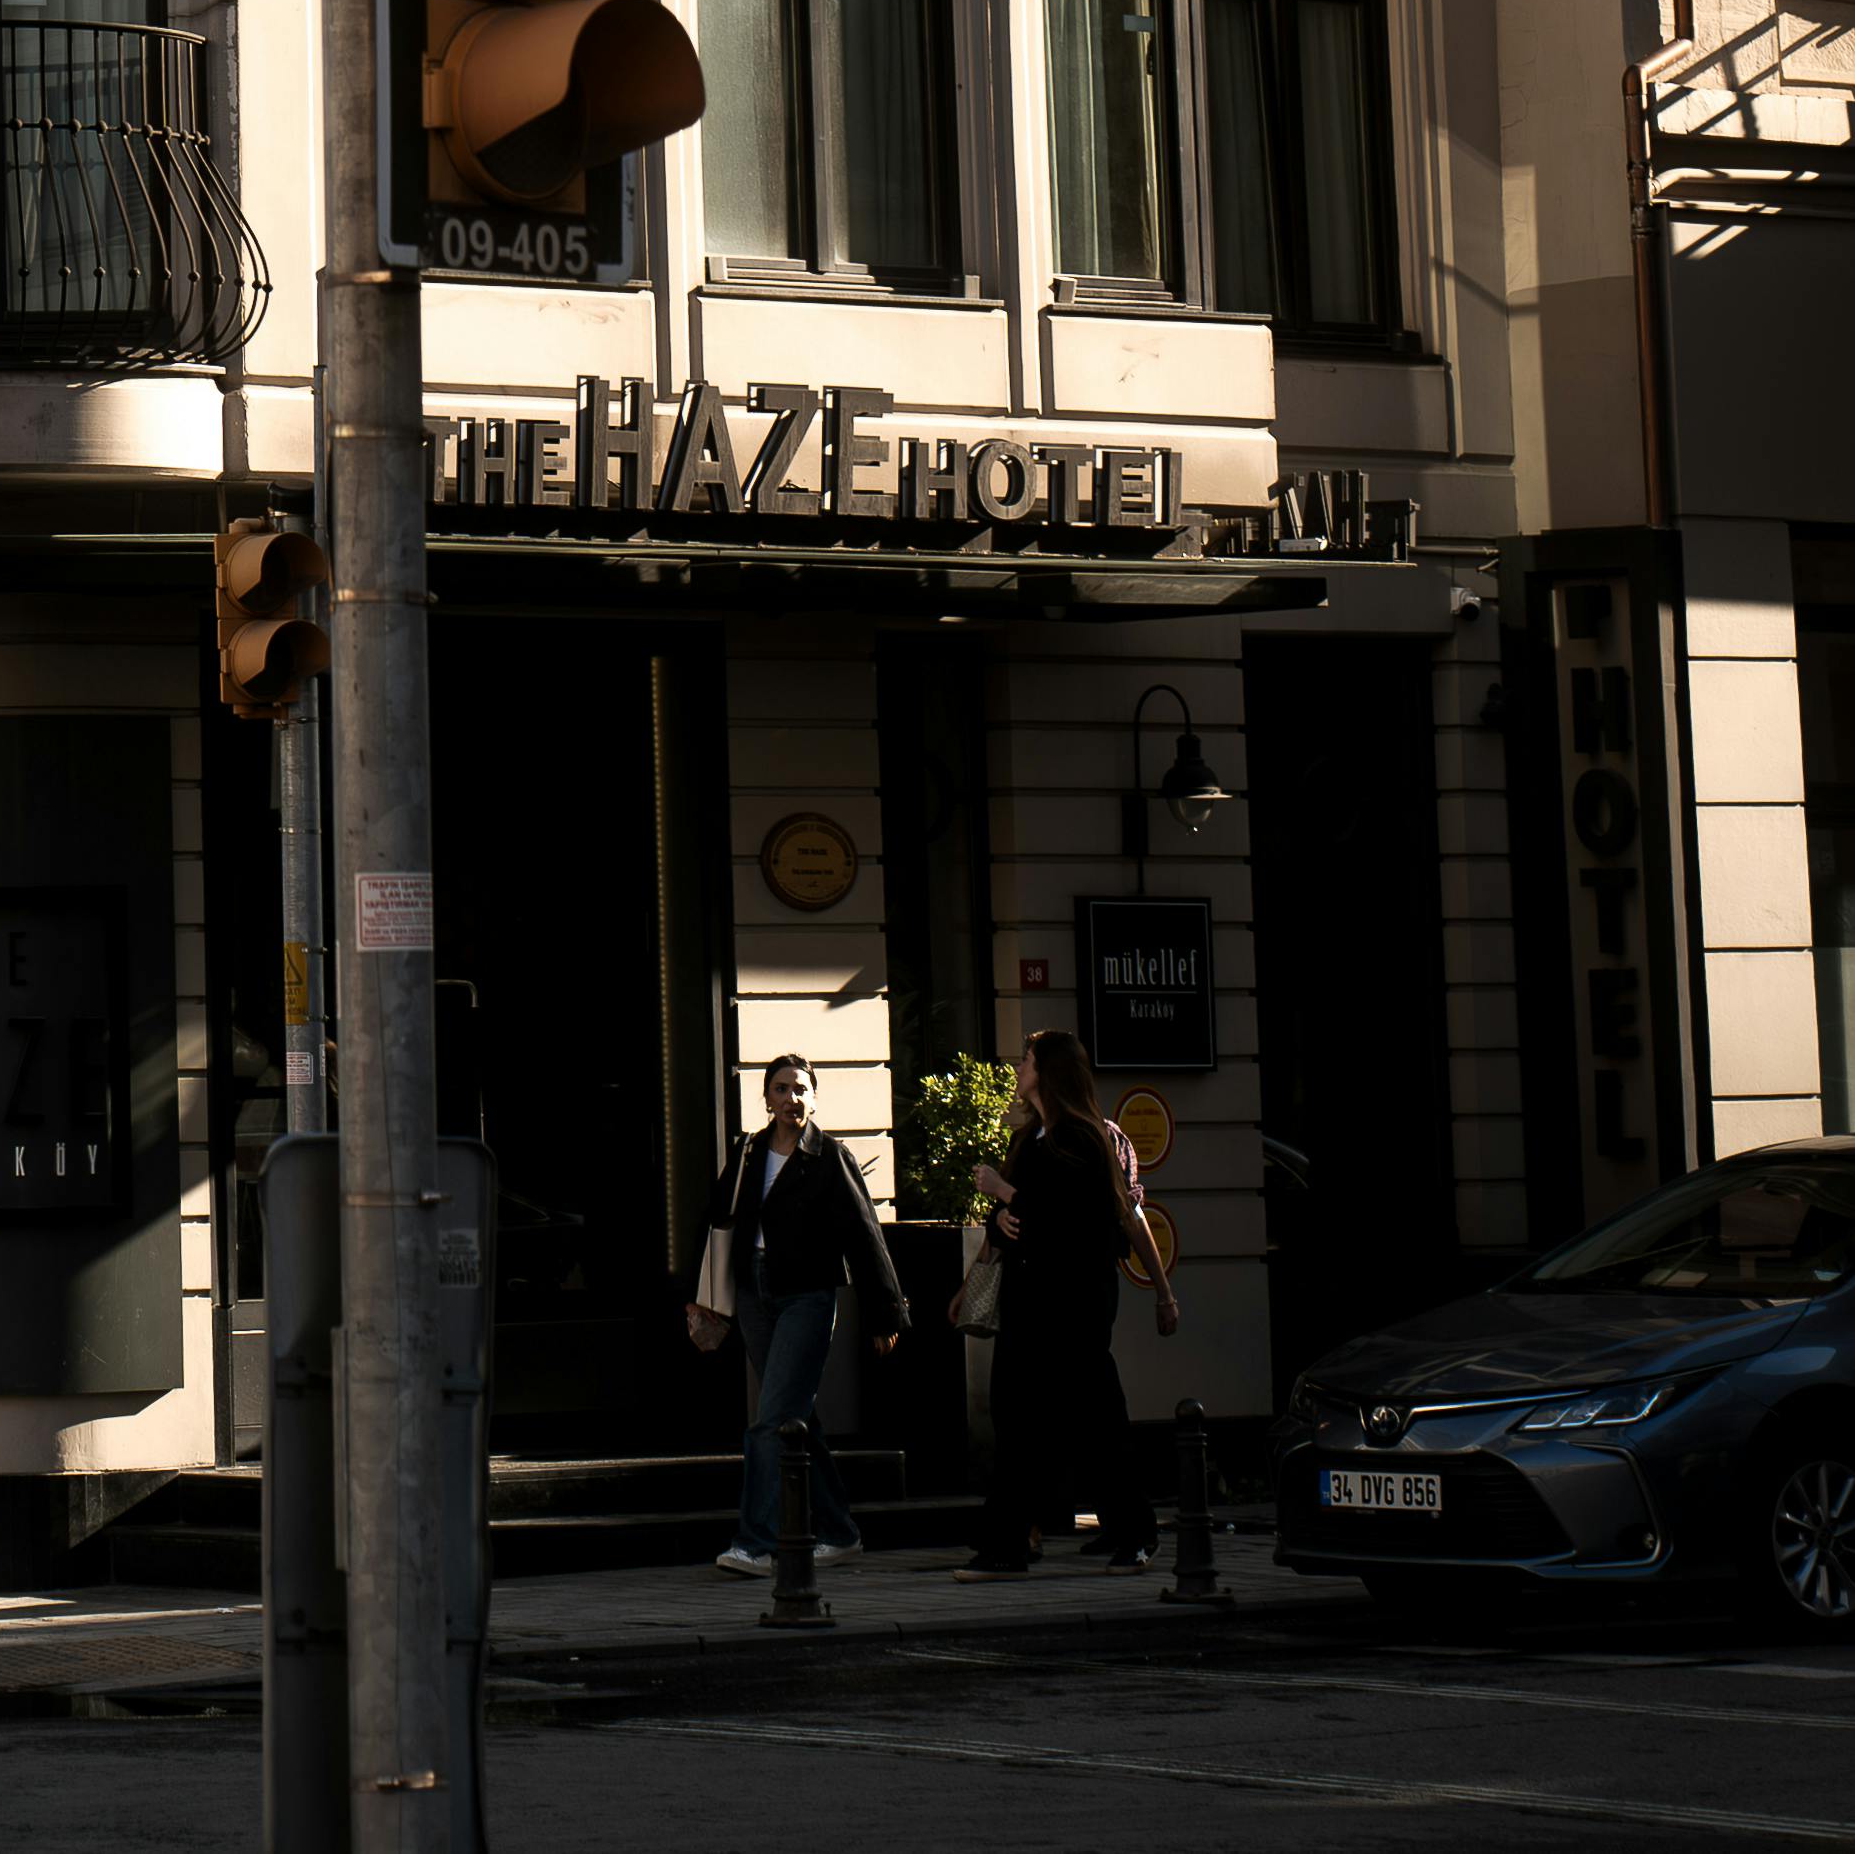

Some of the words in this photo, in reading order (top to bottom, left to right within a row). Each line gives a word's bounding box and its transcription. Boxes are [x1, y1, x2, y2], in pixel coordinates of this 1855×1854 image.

[441, 216, 590, 276] 09-405
[422, 416, 571, 506] THE
[577, 374, 894, 515] HAZE
[899, 437, 1213, 527] HOTEL
[1572, 666, 1645, 1159] HOTEL
[1025, 965, 1043, 983] 38
[1103, 947, 1199, 987] mükellef
[1332, 1474, 1353, 1504] 34
[1361, 1474, 1395, 1505] DVG
[1402, 1476, 1437, 1507] 856
